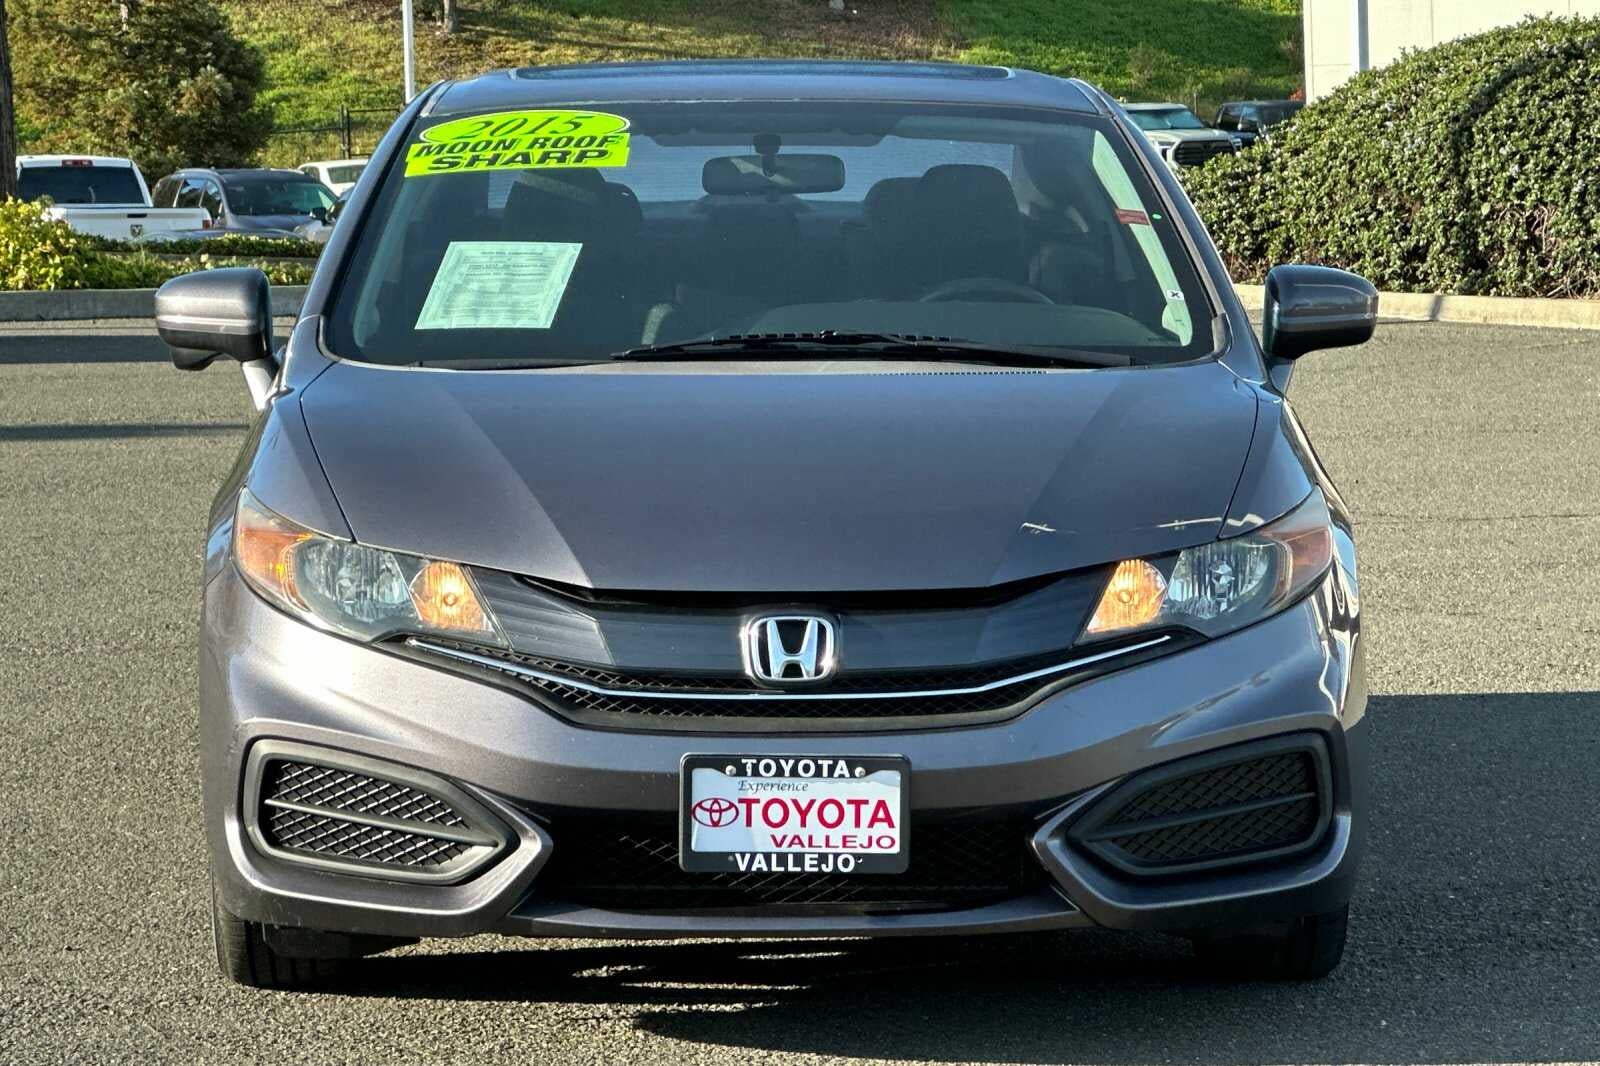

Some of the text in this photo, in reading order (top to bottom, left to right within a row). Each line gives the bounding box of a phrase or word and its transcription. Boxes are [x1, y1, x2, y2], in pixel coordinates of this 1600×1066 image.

[450, 115, 594, 140] 2015
[413, 134, 622, 158] MOON ROOF
[427, 149, 610, 171] SHARP
[741, 758, 850, 778] TOYOTA
[737, 780, 809, 793] Experience
[737, 797, 896, 829] TOYOTA
[770, 834, 896, 849] VALLEJO
[735, 853, 855, 873] VALLEJO
